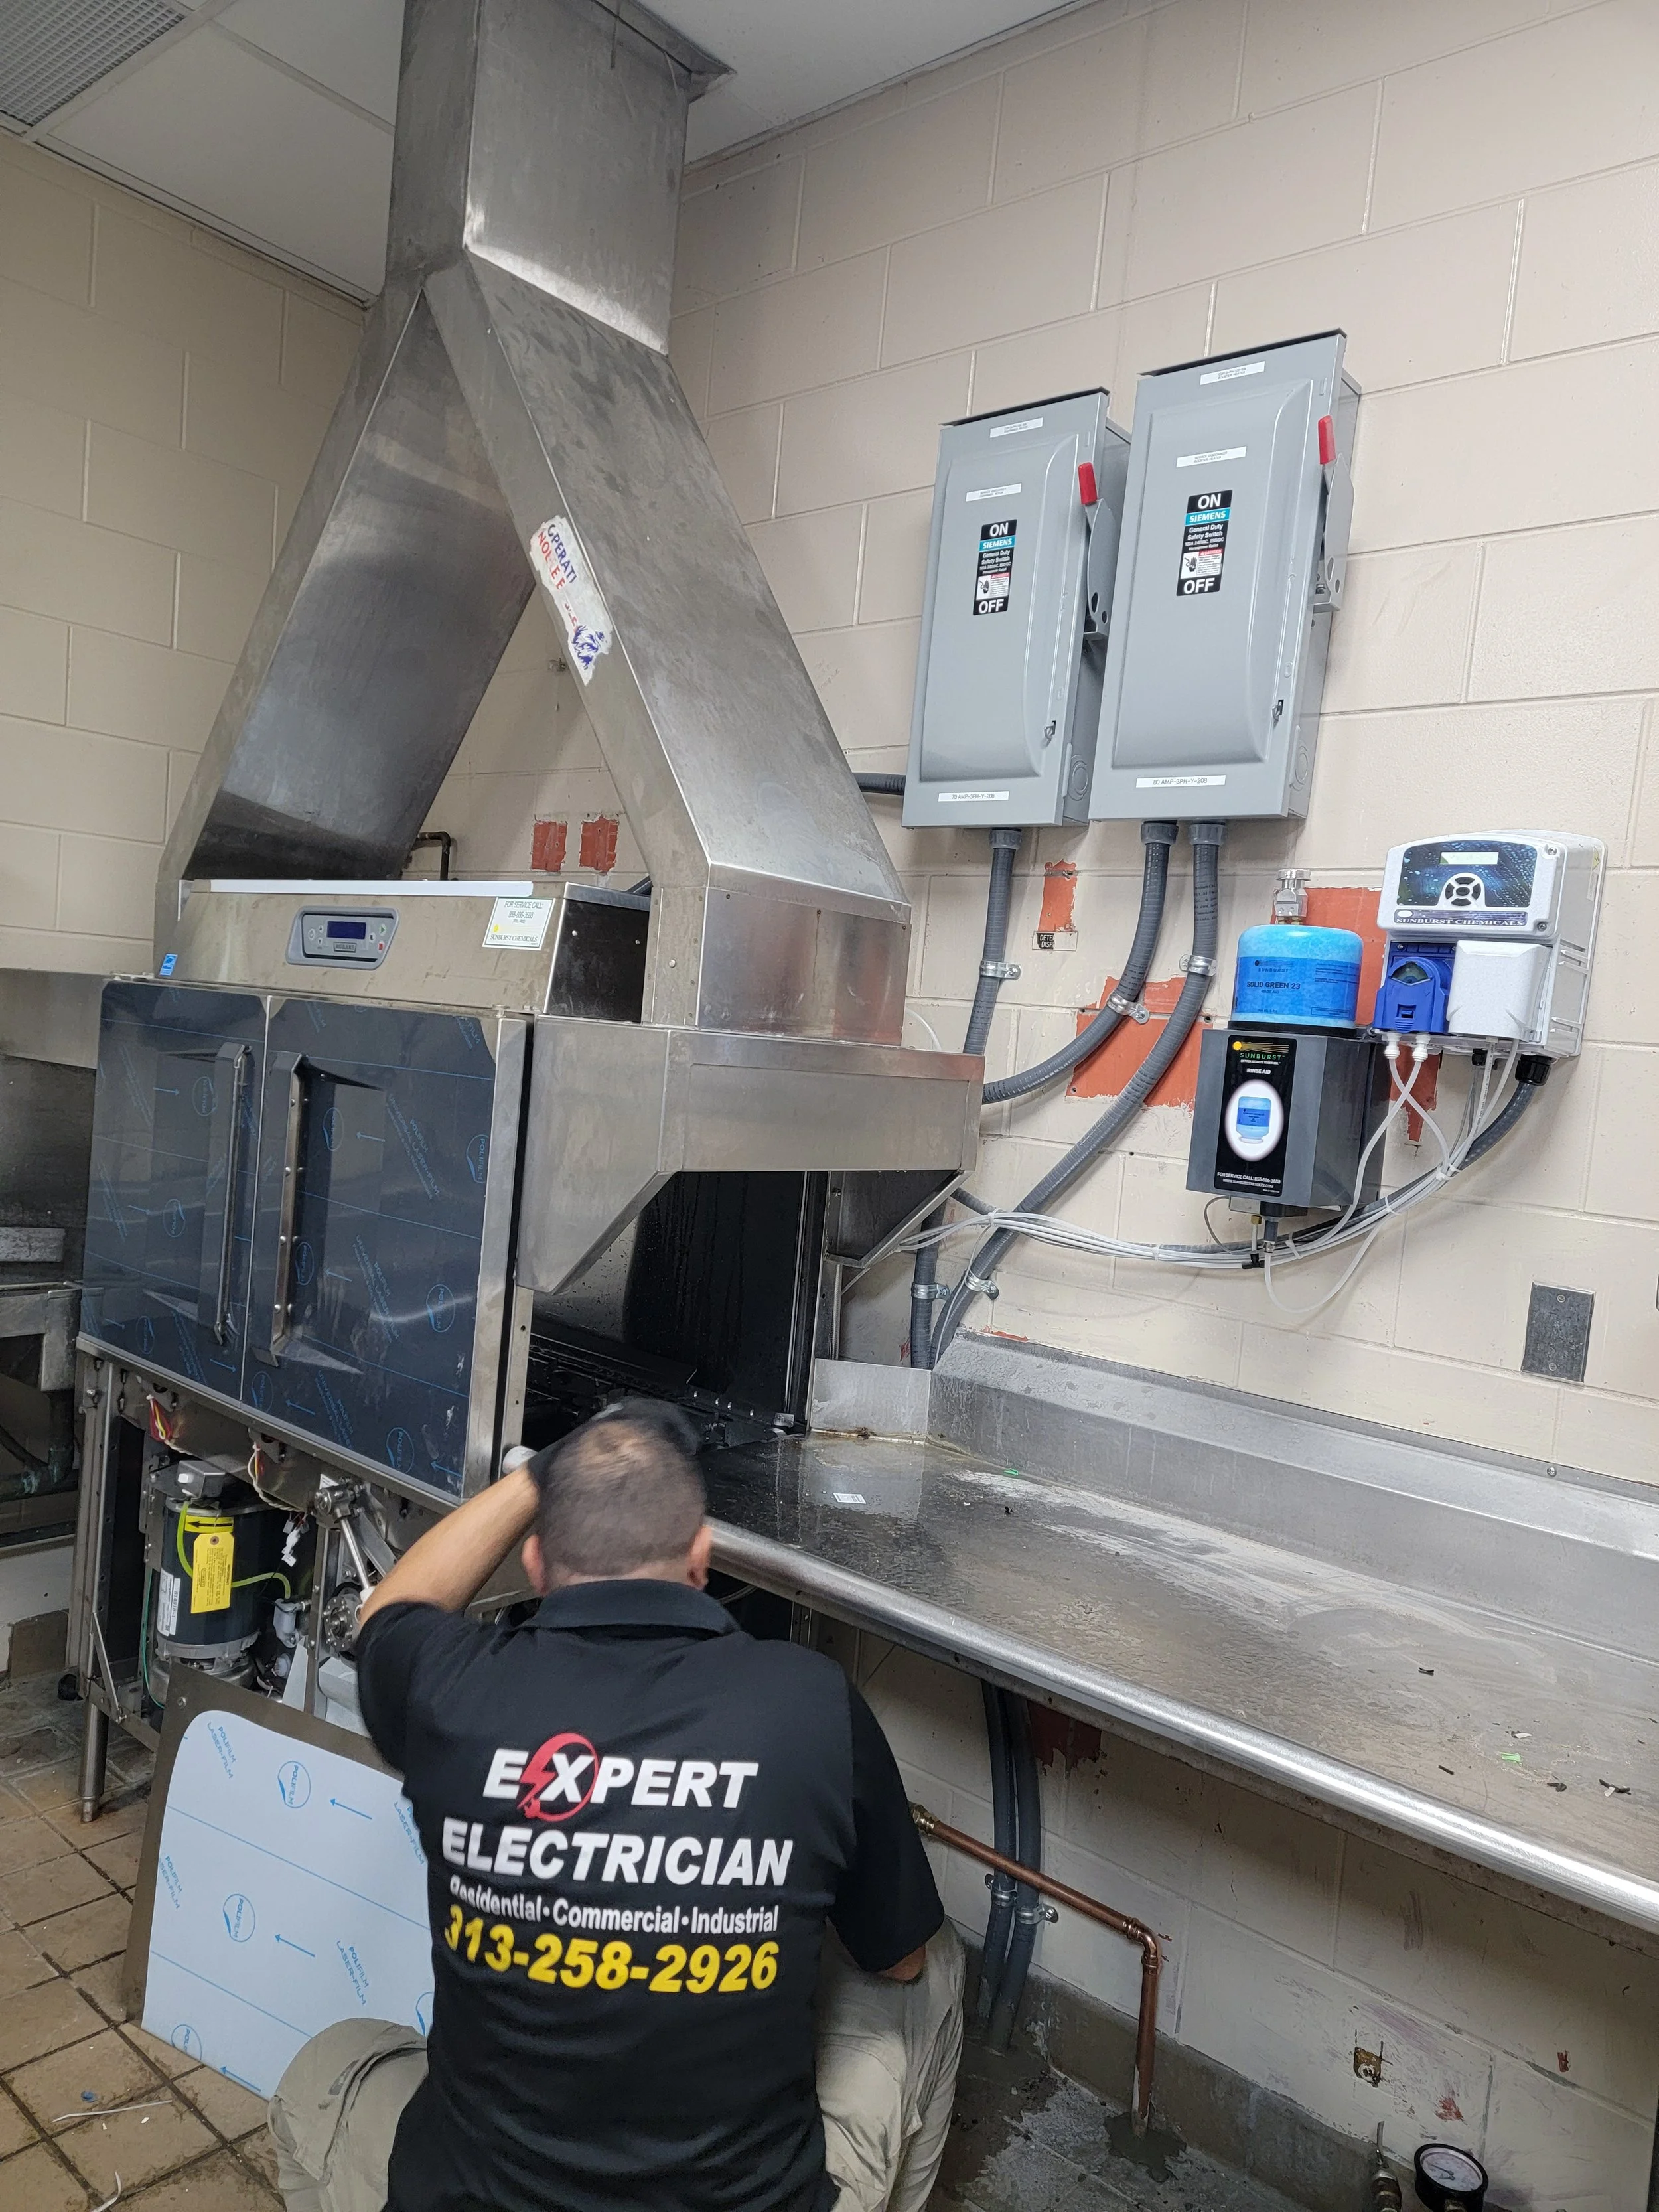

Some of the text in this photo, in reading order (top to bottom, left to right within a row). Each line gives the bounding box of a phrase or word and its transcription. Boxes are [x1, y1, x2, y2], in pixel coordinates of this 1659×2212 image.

[1189, 510, 1226, 523] SIEMENS
[1198, 493, 1221, 509] ON
[983, 538, 1013, 550] SIEMENS
[989, 522, 1009, 537] ON
[1189, 524, 1210, 533] General
[1183, 577, 1215, 595] OFF
[979, 598, 1004, 614] OFF
[1455, 919, 1524, 927] CHEMICALS
[1240, 1052, 1281, 1061] SUNBURST
[476, 1138, 486, 1181] POLIFILM
[208, 1722, 234, 1779] LASER-FILM
[216, 1726, 236, 1763] POLIFILM
[288, 1764, 299, 1805] POLIFILM
[482, 1748, 759, 1808] EXPERT
[443, 1817, 793, 1886] ELECTRICIAN
[159, 1857, 180, 1909] SER-FILM
[165, 1856, 183, 1893] POLIFILM
[233, 1897, 244, 1939] POLIFILM
[348, 1946, 370, 1988] POLIFILM
[444, 1904, 780, 1994] 313-258-2926
[336, 1940, 367, 2006] LASER-FILM
